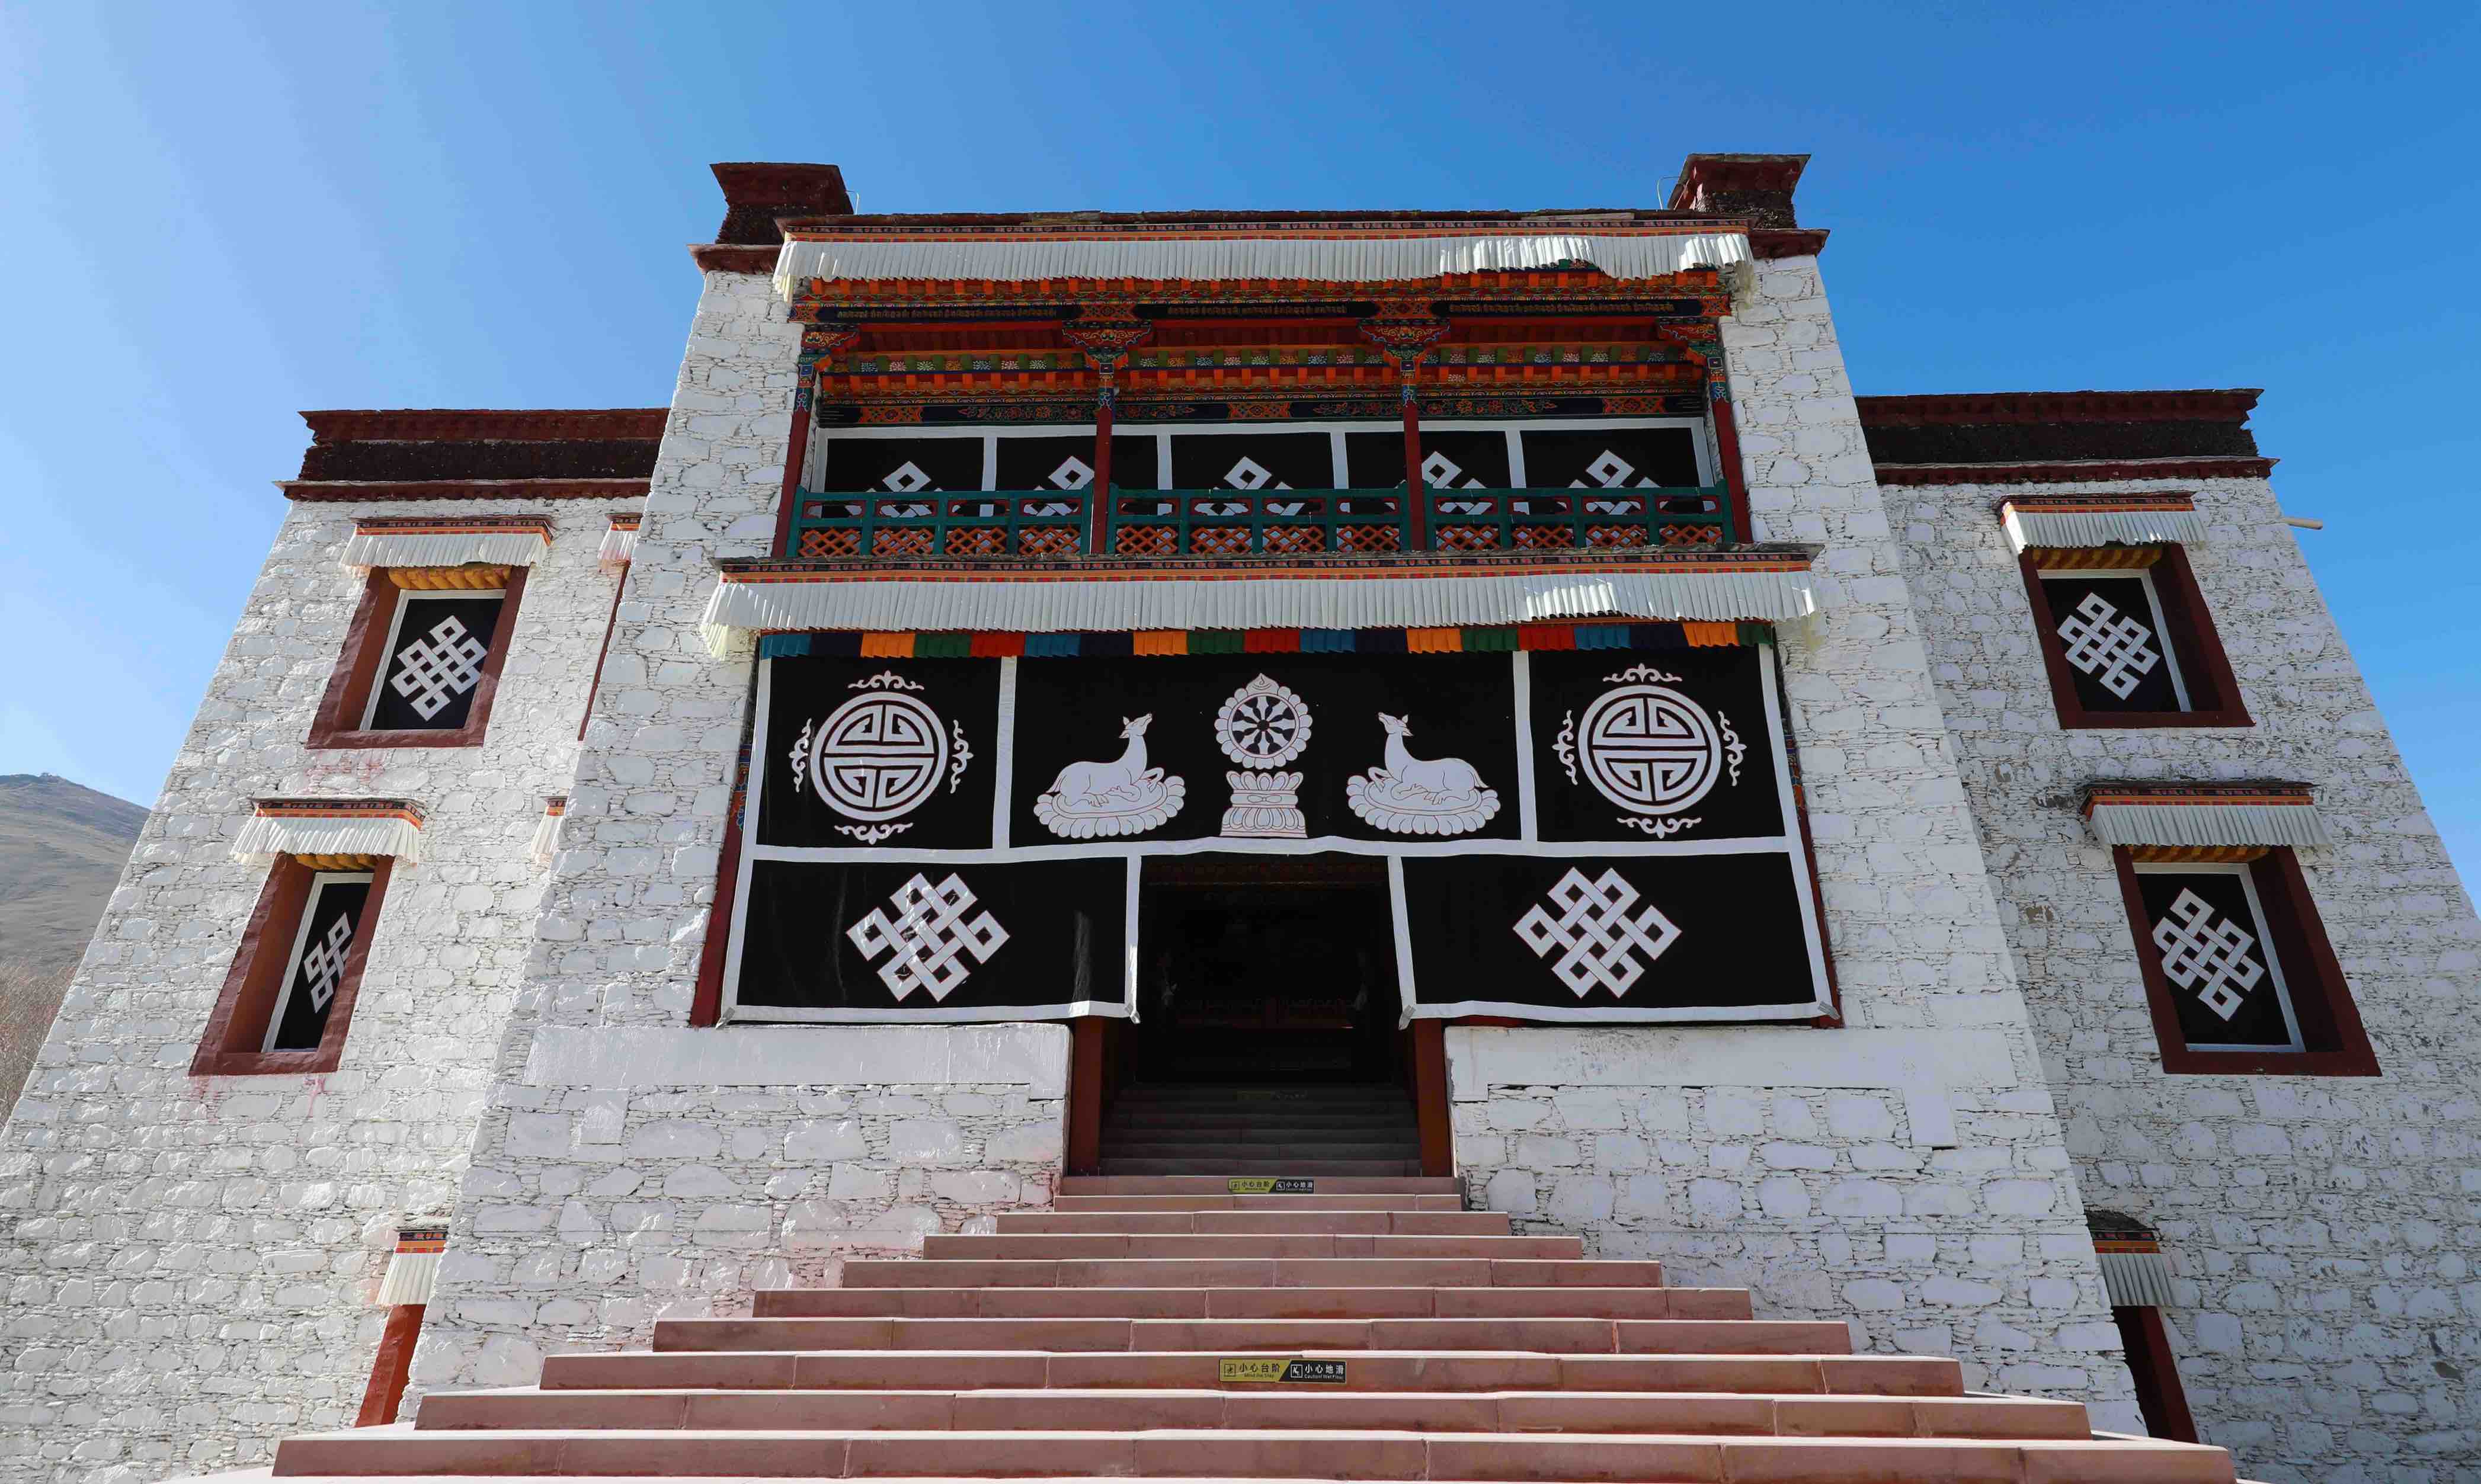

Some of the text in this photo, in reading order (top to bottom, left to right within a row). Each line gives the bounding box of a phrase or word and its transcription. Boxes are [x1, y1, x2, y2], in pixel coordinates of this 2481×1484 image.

[1239, 1363, 1280, 1373] 小心台阶
[1305, 1364, 1344, 1374] 小心地滑
